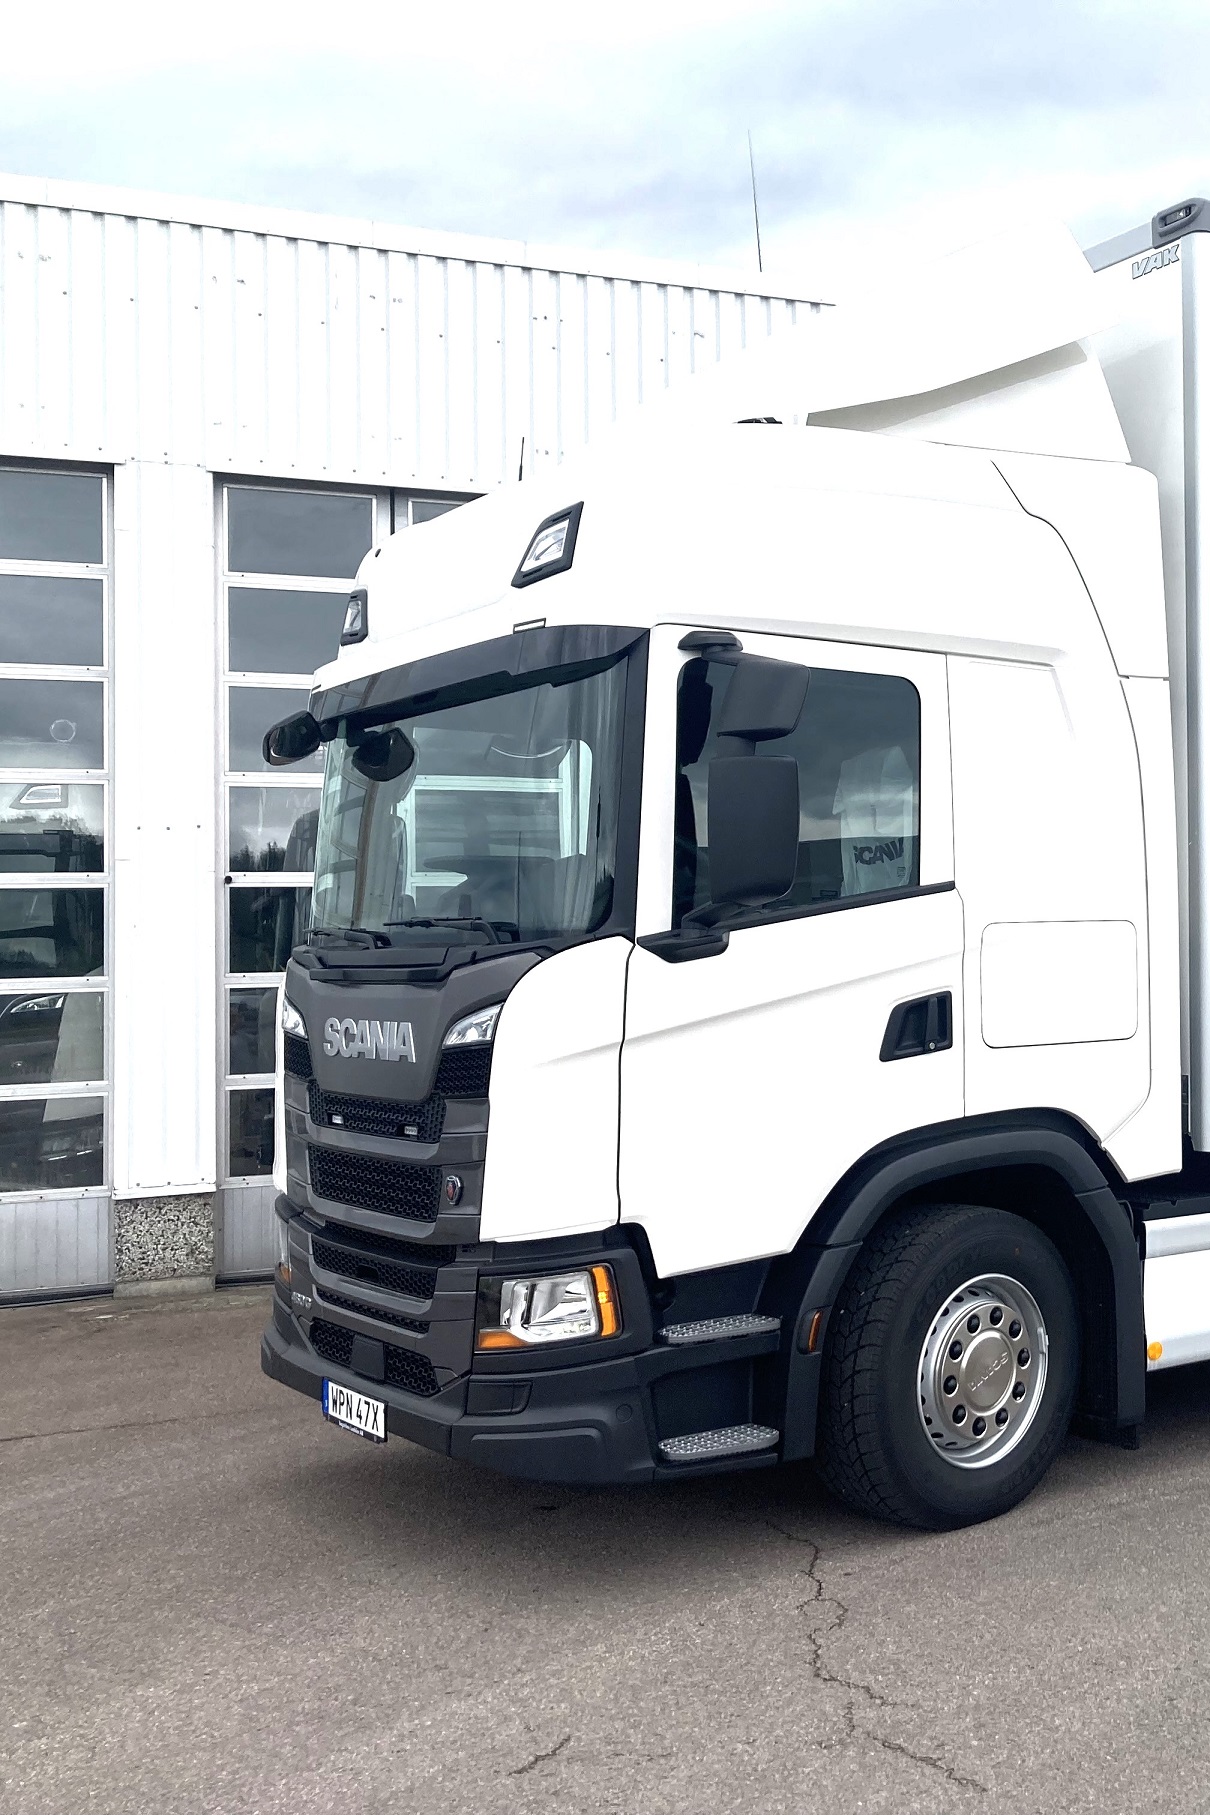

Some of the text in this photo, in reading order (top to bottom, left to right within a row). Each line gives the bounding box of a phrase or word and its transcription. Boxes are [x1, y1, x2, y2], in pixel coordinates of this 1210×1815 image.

[1131, 244, 1181, 280] VAK
[323, 1017, 416, 1063] SCANIA
[331, 1385, 353, 1421] WPN
[356, 1397, 379, 1432] 47X
